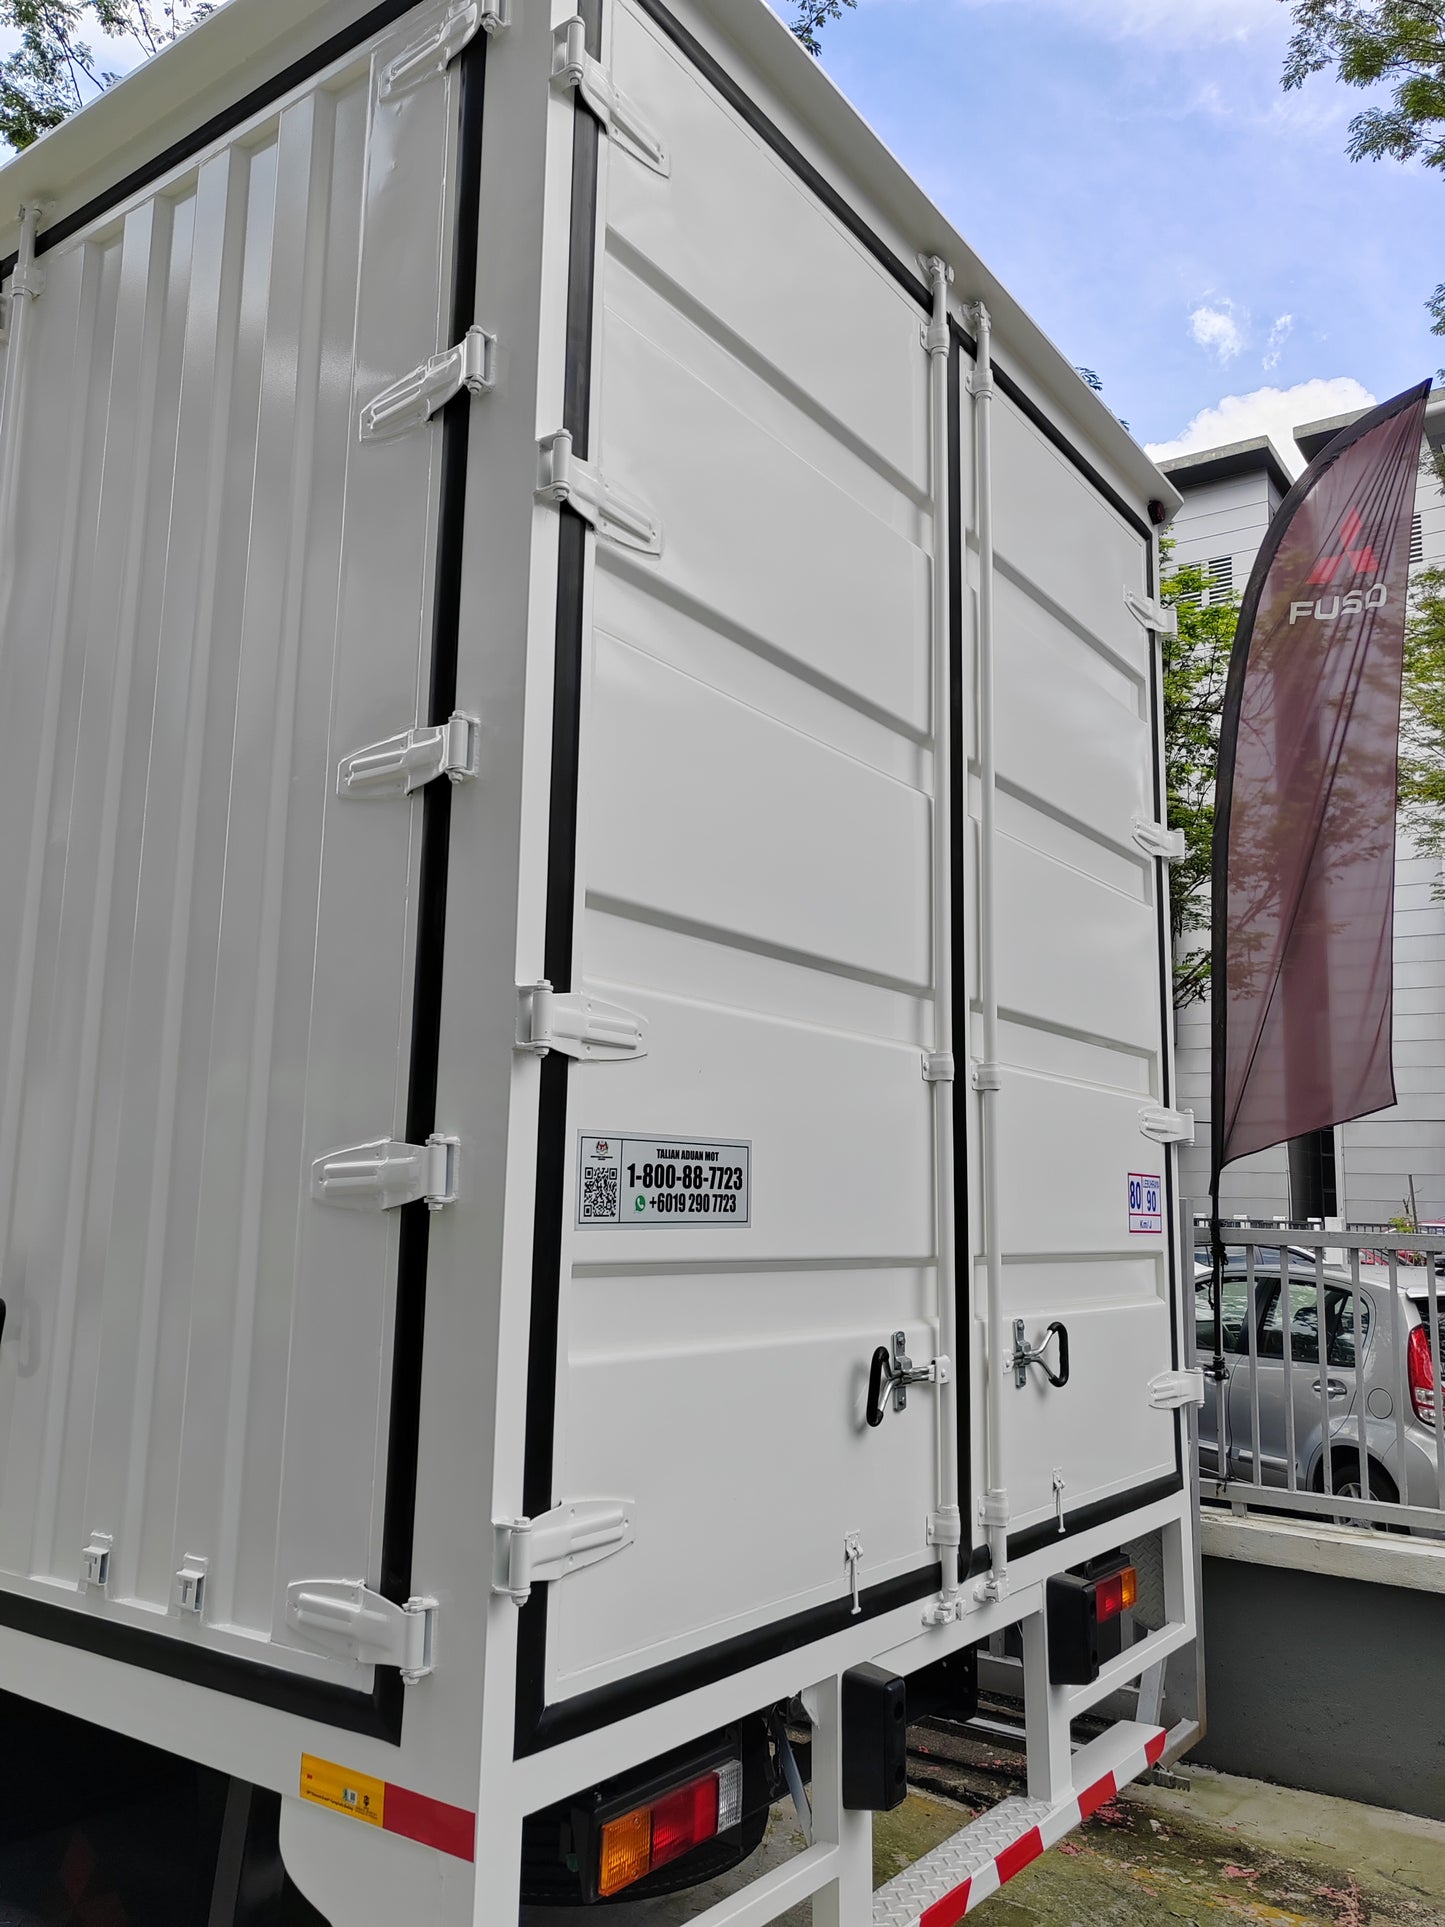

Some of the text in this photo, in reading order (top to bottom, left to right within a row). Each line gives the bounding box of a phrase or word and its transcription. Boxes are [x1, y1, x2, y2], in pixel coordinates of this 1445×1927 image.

[1289, 583, 1387, 625] FUSO
[656, 1149, 719, 1162] TALIAN ADUAN MOT
[627, 1163, 743, 1190] 1-800-88-7723
[649, 1193, 737, 1213] +6019 290 7723
[1130, 1181, 1141, 1210] 80
[1147, 1190, 1156, 1211] 90
